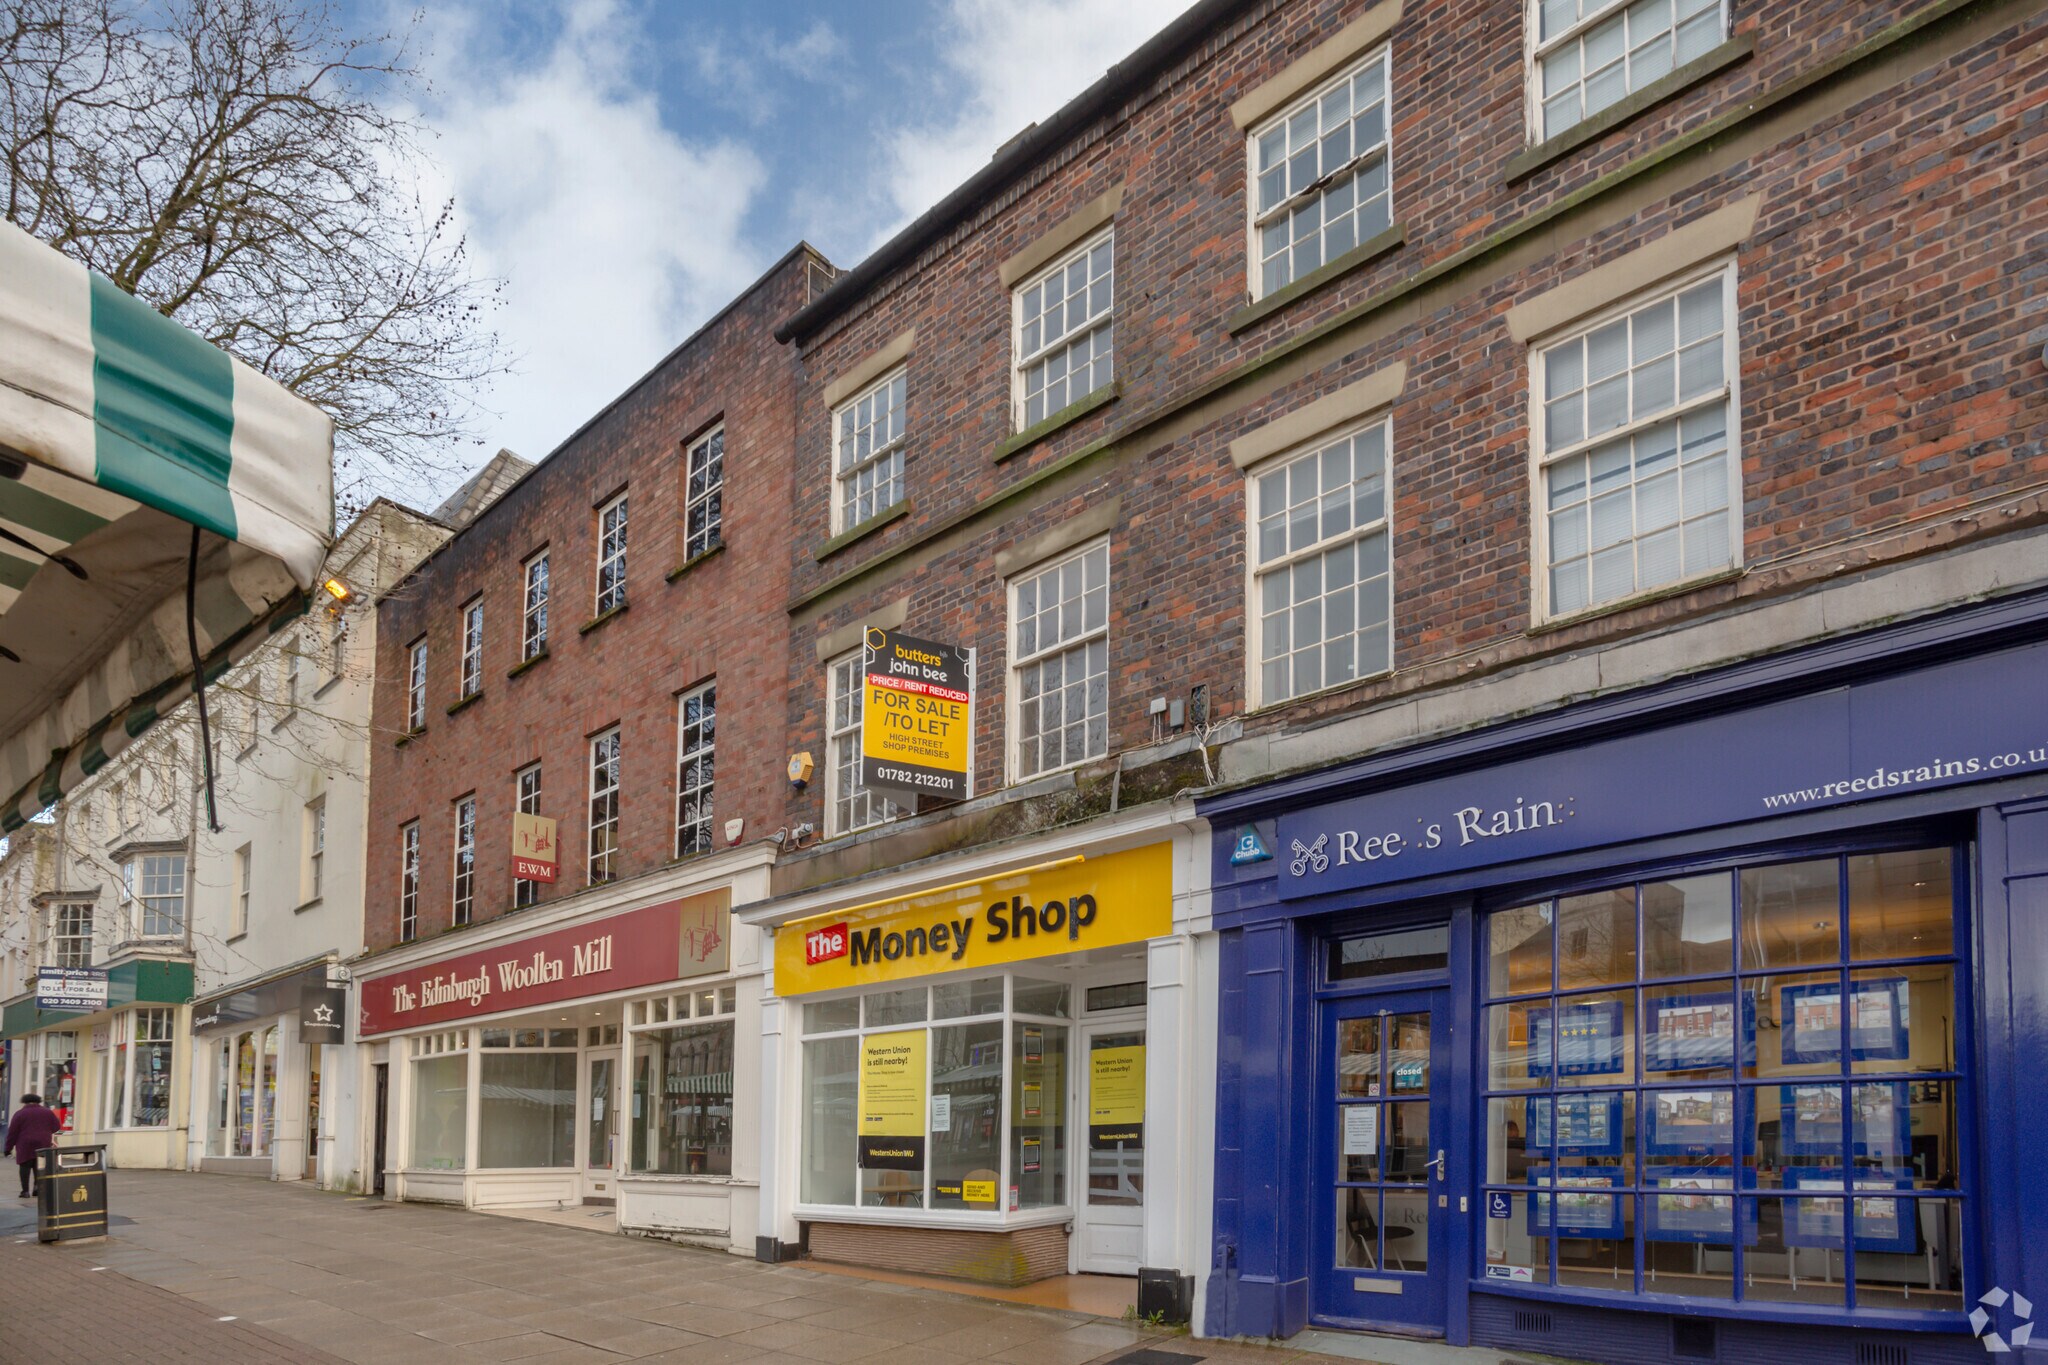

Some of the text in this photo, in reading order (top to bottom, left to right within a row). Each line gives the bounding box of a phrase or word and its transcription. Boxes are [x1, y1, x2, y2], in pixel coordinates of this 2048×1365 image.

[895, 644, 942, 667] butters
[889, 658, 948, 682] john bee
[872, 676, 899, 688] PRICE
[904, 681, 928, 693] RENT
[929, 686, 967, 702] REDUCED
[873, 689, 960, 720] FOR SALE
[884, 711, 950, 736] /TO LET
[883, 740, 950, 759] SHOP PREMISES
[889, 733, 943, 749] HIGH STREET
[877, 767, 954, 789] 01782 212201
[1763, 740, 2048, 808] www.reedsrains.co.u
[1235, 847, 1260, 859] Chubb
[518, 862, 551, 877] EWM
[808, 893, 1096, 966] The Money Shop
[392, 935, 613, 1013] The Edinburgh Woollen Mill
[892, 1046, 911, 1054] Union
[867, 1057, 908, 1066] is still nearby!
[1396, 1066, 1422, 1076] closed
